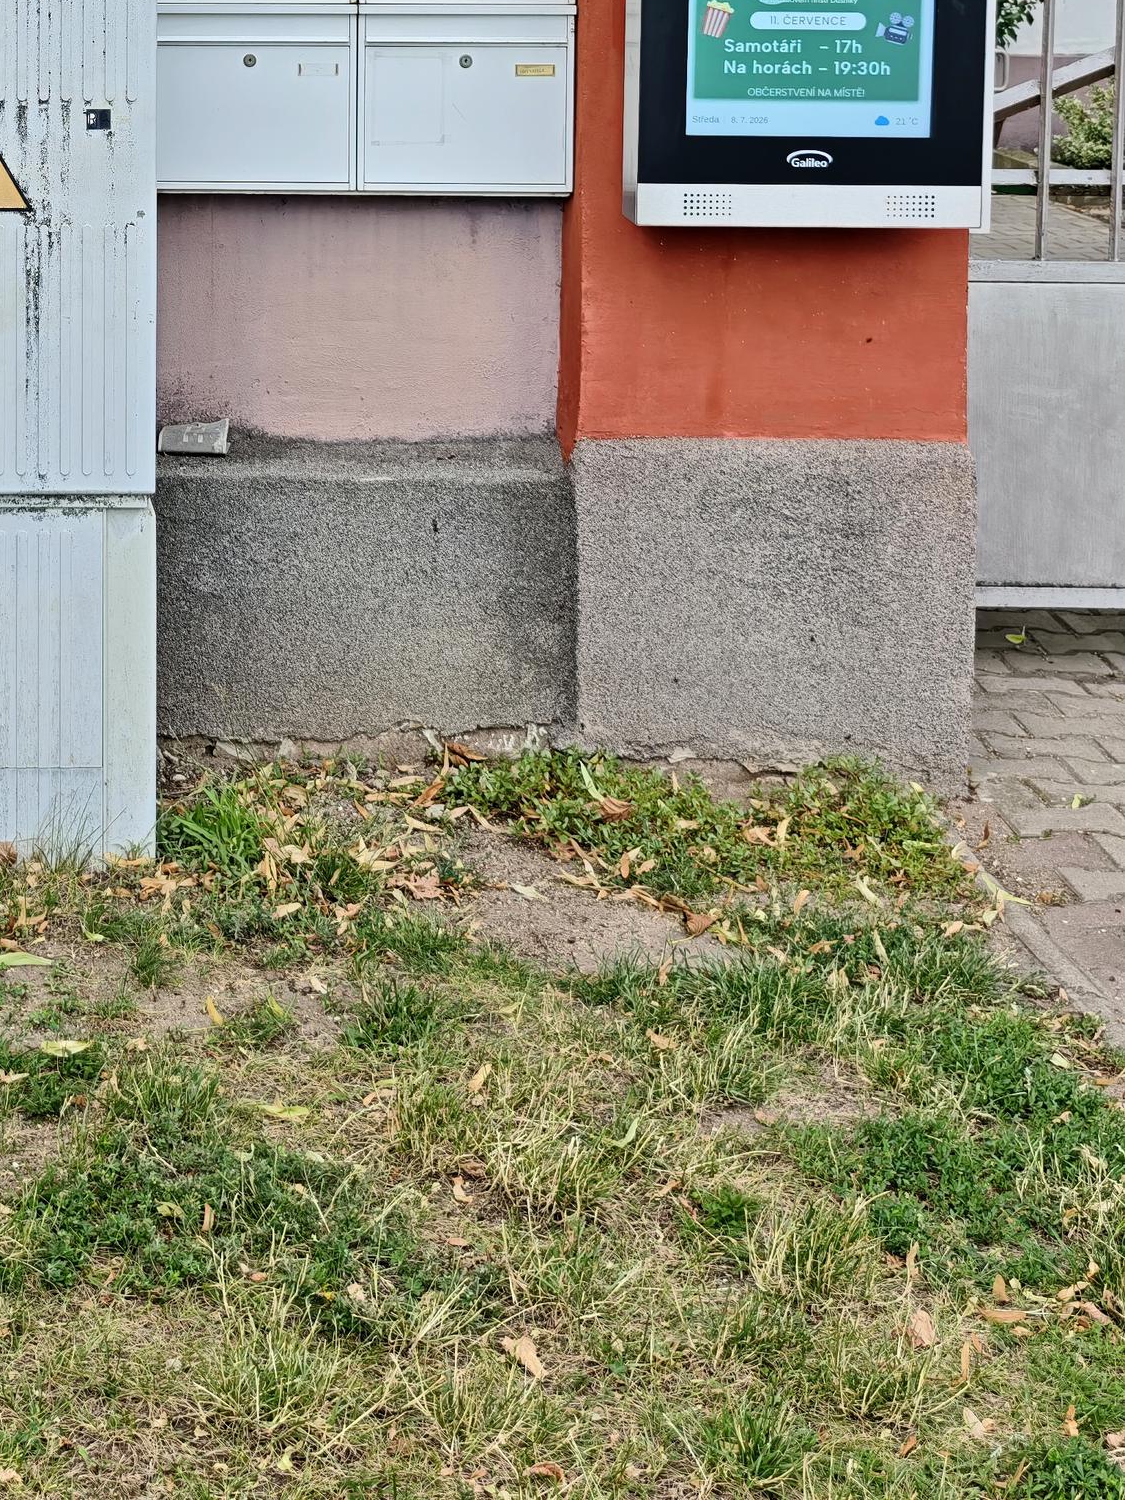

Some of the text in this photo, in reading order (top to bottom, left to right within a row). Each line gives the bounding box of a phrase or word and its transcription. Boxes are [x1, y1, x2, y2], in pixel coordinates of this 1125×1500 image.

[783, 14, 847, 26] ČERVENCE
[724, 38, 802, 53] Samotáři
[835, 39, 863, 54] 17h
[723, 60, 747, 74] Na
[752, 60, 812, 75] horách
[834, 60, 891, 76] 19:30h
[747, 86, 865, 98] OBČERSTVENÍ NA MÍSTĚ!
[791, 158, 828, 168] Galileo
